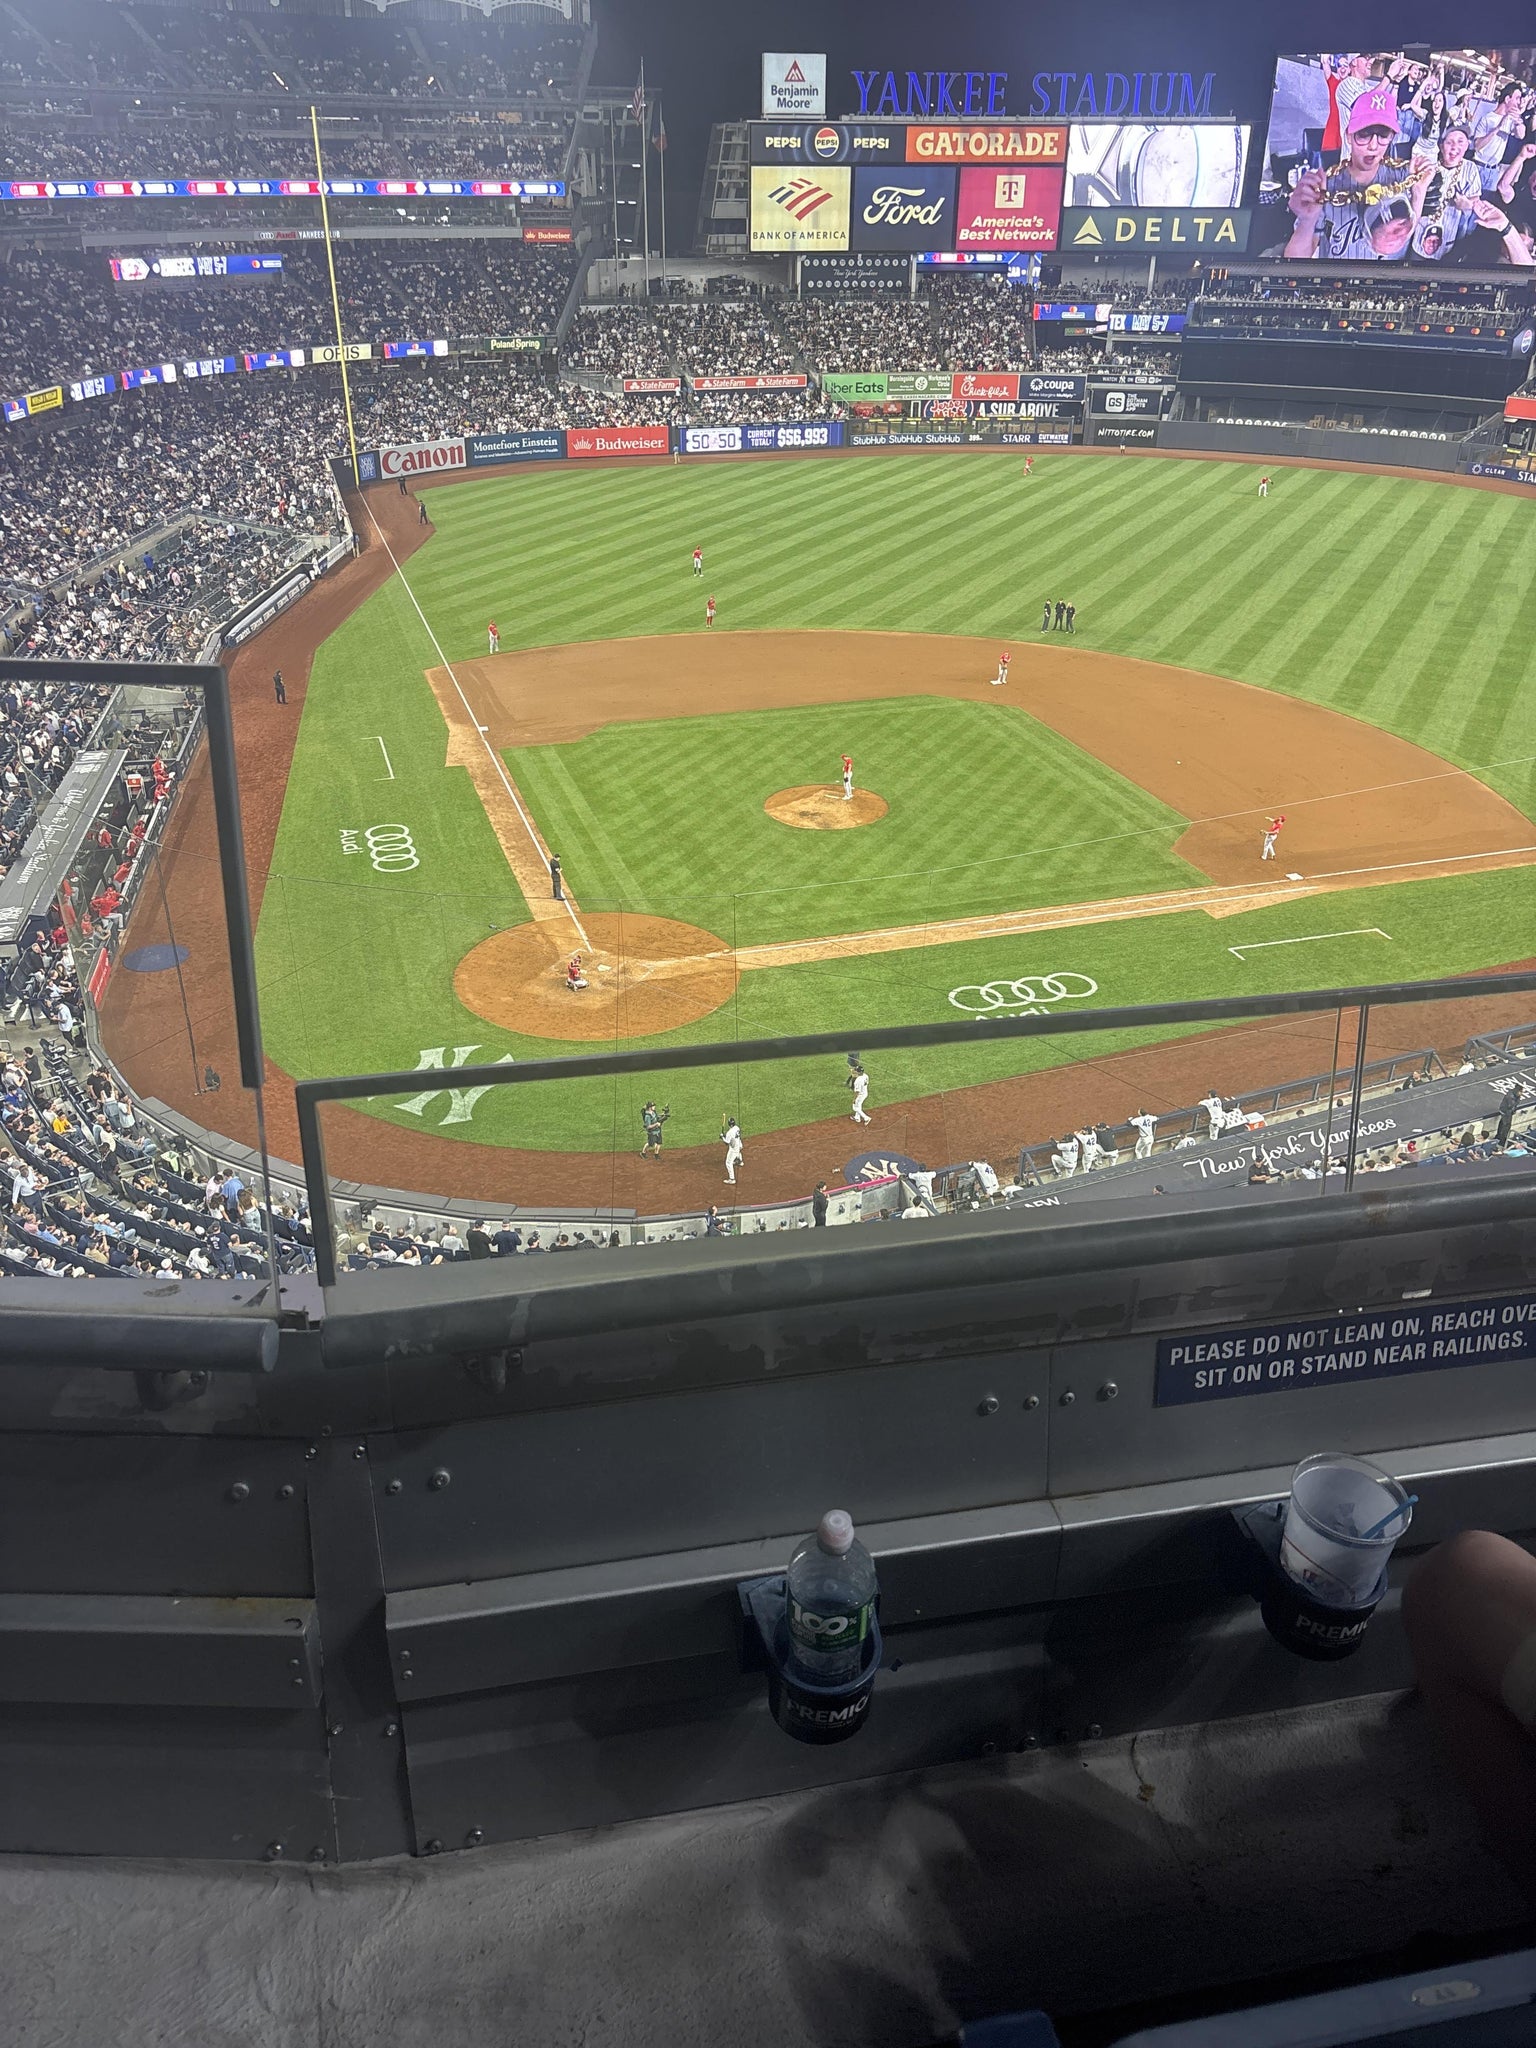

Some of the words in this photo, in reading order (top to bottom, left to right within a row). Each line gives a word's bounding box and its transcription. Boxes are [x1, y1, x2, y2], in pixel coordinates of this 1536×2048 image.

[771, 85, 819, 99] Benjamin
[851, 71, 1008, 116] YANKEE
[1030, 72, 1216, 116] STADIUM
[777, 97, 810, 109] Moore
[765, 136, 801, 149] PEPSI
[816, 139, 838, 147] PEPSI
[853, 137, 889, 149] PEPSI
[915, 132, 1059, 157] GATORADE
[863, 186, 946, 225] Ford
[971, 216, 1044, 228] America's
[298, 231, 326, 239] YANKEES
[538, 231, 570, 240] Budweiser
[753, 231, 781, 240] BANK
[783, 231, 797, 240] OF
[799, 231, 847, 240] AMERICA
[959, 229, 991, 241] Best
[993, 229, 1055, 241] Network
[1115, 217, 1237, 242] DELTA
[1109, 314, 1127, 330] TEX
[1151, 315, 1169, 332] 5-7
[490, 338, 516, 350] Poland
[515, 338, 540, 350] Spring
[825, 383, 853, 394] Uber
[855, 382, 884, 394] Eats
[960, 380, 1010, 398] Chick-fil-A
[1043, 380, 1074, 392] coupa
[1108, 398, 1123, 407] GS
[979, 402, 987, 418] A
[990, 402, 1016, 417] SUB
[1019, 402, 1060, 418] ABOVE
[747, 429, 776, 439] CURRENT
[853, 436, 887, 446] StubHub
[888, 434, 923, 444] StubHub
[925, 433, 961, 443] StubHub
[1002, 434, 1031, 443] STARR
[1097, 428, 1155, 439] NITTOTIRE.COM
[474, 438, 520, 453] Montefiore
[522, 437, 558, 448] Einstein
[595, 437, 663, 451] Budweiser
[692, 434, 710, 449] 50
[718, 433, 736, 448] 50
[750, 438, 772, 447] TOTAL:
[382, 444, 464, 475] Canon
[1484, 467, 1506, 476] CLEAR
[338, 829, 364, 855] Audi
[1142, 1119, 1151, 1127] 42
[1086, 1137, 1096, 1146] 42
[1182, 1156, 1246, 1178] New
[1298, 1117, 1397, 1156] Yankees
[1069, 1144, 1079, 1153] 42
[1170, 1339, 1246, 1366] PLEASE
[1252, 1335, 1281, 1356] DO
[1286, 1328, 1328, 1351] NOT
[1333, 1322, 1385, 1345] LEAN
[1390, 1317, 1426, 1338] ON,
[1431, 1308, 1496, 1333] REACH
[1194, 1367, 1227, 1389] SIT
[1232, 1363, 1262, 1384] ON
[1268, 1358, 1296, 1379] OR
[1300, 1350, 1368, 1376] STAND
[1373, 1341, 1427, 1366] NEAR
[1432, 1329, 1529, 1357] RAILINGS.
[787, 1694, 870, 1723] PREMIO
